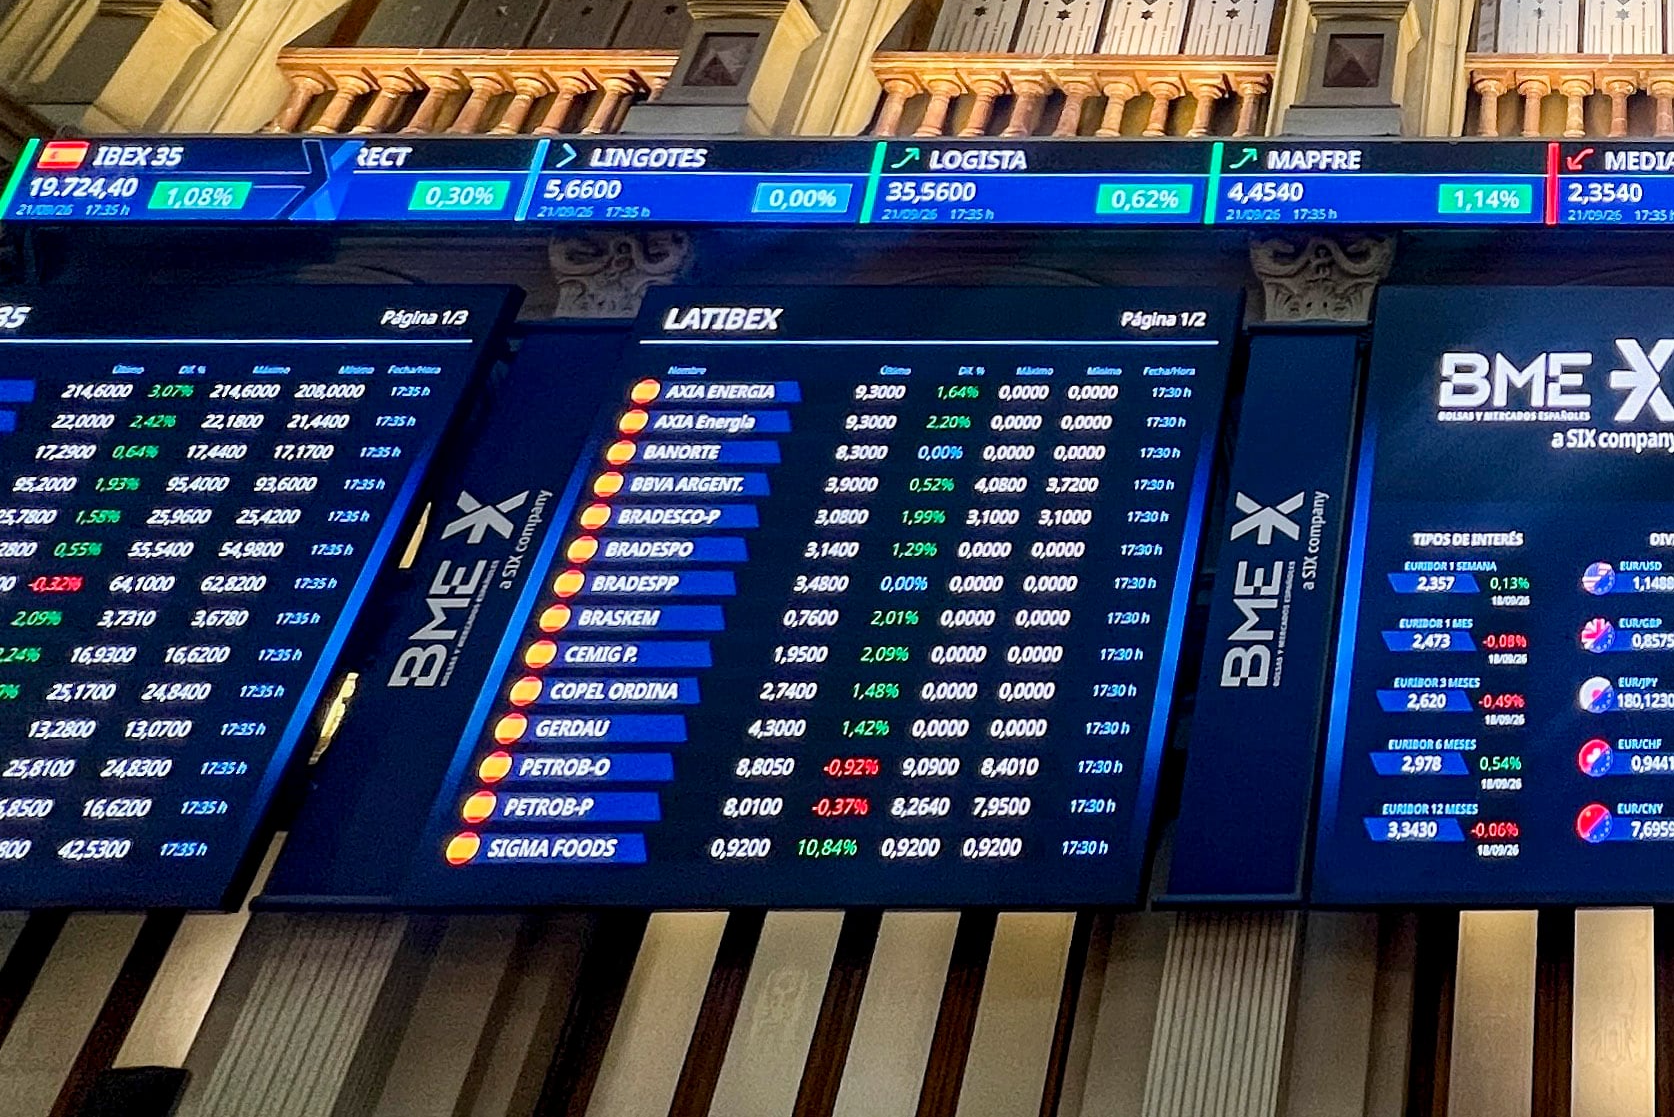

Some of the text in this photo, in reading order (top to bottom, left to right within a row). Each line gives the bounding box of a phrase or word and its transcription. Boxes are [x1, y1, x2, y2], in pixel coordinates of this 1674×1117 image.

[93, 146, 184, 167] IBEX 35
[590, 148, 707, 168] LINGOTES
[930, 150, 1027, 170] LOGISTA
[1267, 150, 1361, 171] MAPFRE
[28, 177, 232, 207] 19.724,40 1,08%
[425, 185, 494, 206] 0,30%
[543, 179, 836, 209] 5,6600 0,00%
[885, 181, 1178, 210] 35,5600 0,62%
[1228, 182, 1519, 210] 4,4540 1,14%
[1568, 183, 1642, 204] 2,3540
[381, 309, 438, 327] Página
[442, 309, 469, 326] 1/3
[663, 307, 1207, 331] LATIBEX Página 1/2
[1438, 352, 1593, 408] BME
[665, 384, 706, 399] AXIA
[653, 415, 696, 430] AXIA
[1551, 433, 1564, 449] a
[1567, 428, 1597, 449] SIX
[643, 445, 721, 460] BANORTE
[630, 477, 744, 492] BBVA ARGENT.
[617, 509, 722, 525] BRADESCO-P
[1308, 491, 1330, 554] company
[502, 555, 523, 579] SIX
[515, 490, 553, 552] company
[1412, 530, 1524, 547] TIPOS DE INTERÉS
[605, 542, 694, 557] BRADESPO
[1302, 556, 1319, 579] SIX
[591, 575, 680, 591] BRADESPP
[387, 560, 487, 687] BME
[578, 610, 660, 626] BRASKEM
[1220, 561, 1283, 687] BME
[70, 646, 137, 665] 16,9300
[564, 646, 638, 663] CEMIG P.
[550, 682, 679, 699] COPEL ORDINA
[535, 719, 610, 737] GERDAU
[519, 758, 610, 776] PETROB-O
[503, 798, 595, 816] PETROB-P
[890, 797, 1032, 818] 8,2640 7,9500
[487, 838, 618, 858] SIGMA FOODS
